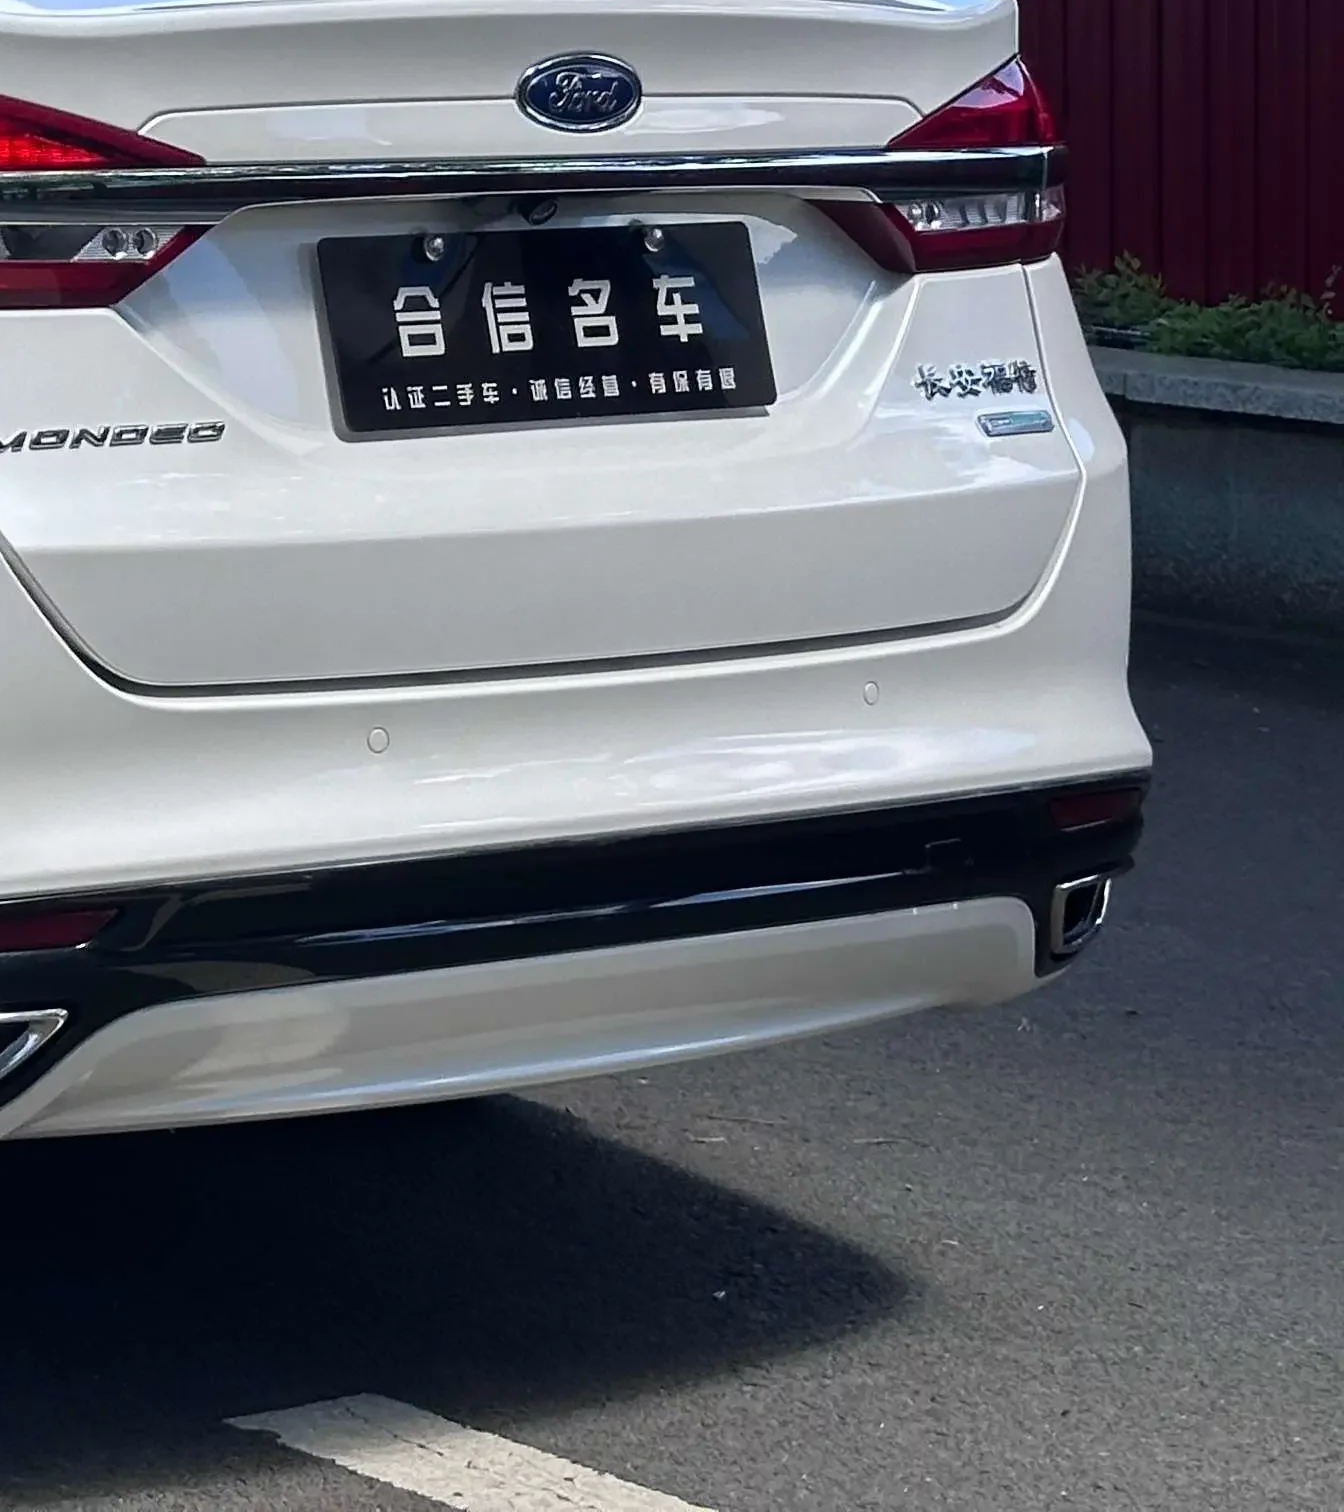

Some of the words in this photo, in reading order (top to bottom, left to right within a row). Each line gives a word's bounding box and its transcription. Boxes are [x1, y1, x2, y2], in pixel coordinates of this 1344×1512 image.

[549, 71, 618, 113] Ford
[393, 274, 703, 357] 合信名车
[913, 360, 1037, 401] 长安福特
